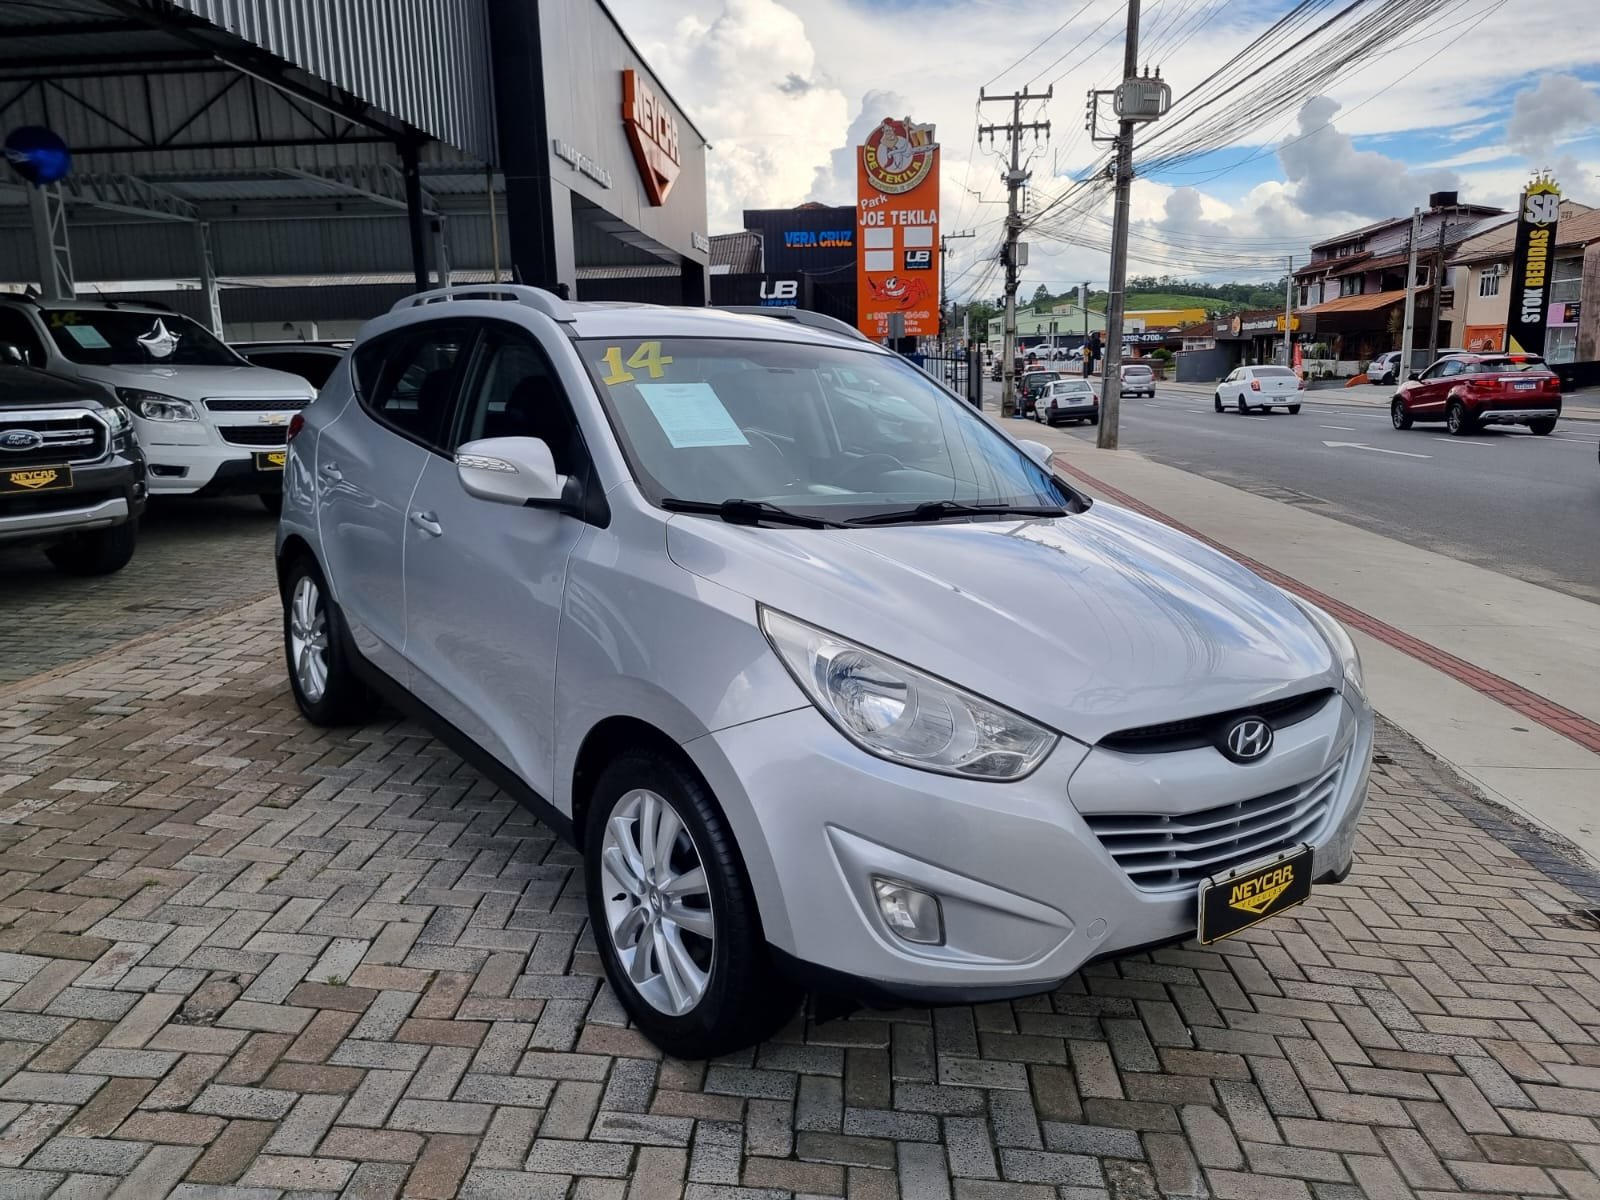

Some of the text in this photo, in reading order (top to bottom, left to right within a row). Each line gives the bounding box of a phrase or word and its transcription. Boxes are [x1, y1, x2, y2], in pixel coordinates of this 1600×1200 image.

[633, 69, 680, 167] NEYCAR
[866, 145, 878, 170] JOE
[878, 161, 922, 183] TEKILA
[860, 194, 888, 210] Park
[1524, 194, 1560, 223] SB
[860, 209, 938, 225] JOE TEKILA
[784, 231, 853, 247] VERA CRUZ
[906, 251, 930, 262] UB
[1520, 229, 1550, 323] STOK BEBIDAS
[759, 280, 798, 300] UB
[760, 299, 798, 307] URBAN
[601, 341, 673, 385] 14
[9, 470, 58, 481] NEYCAR
[1228, 864, 1295, 904] NEYCAR
